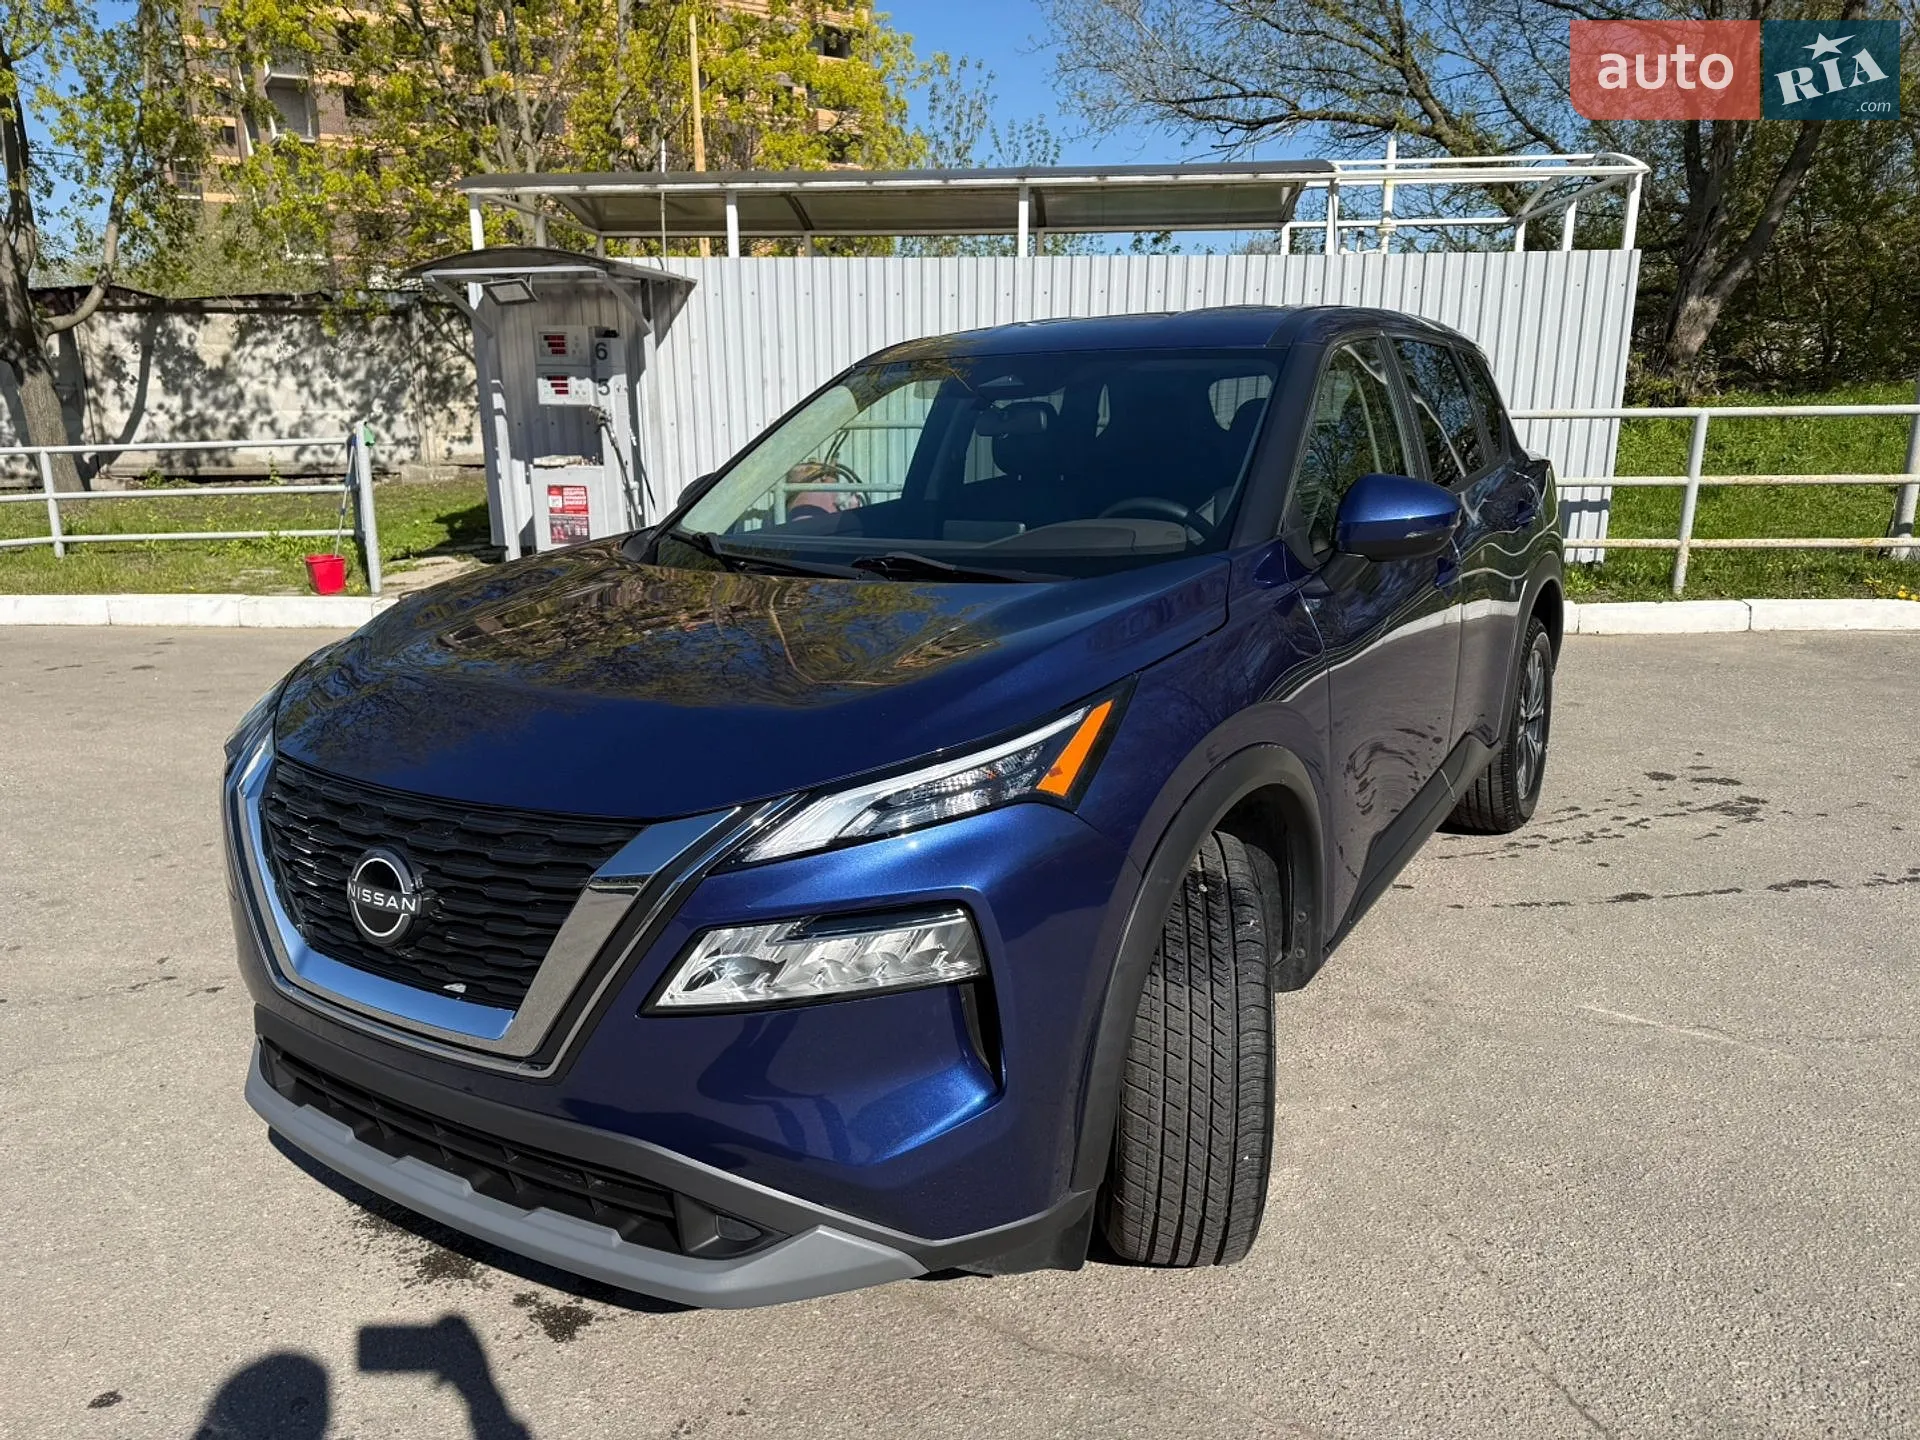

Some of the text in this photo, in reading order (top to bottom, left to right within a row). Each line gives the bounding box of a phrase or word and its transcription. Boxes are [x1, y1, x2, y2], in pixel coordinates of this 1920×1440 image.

[595, 342, 608, 360] 6
[598, 378, 610, 396] 5
[347, 881, 416, 912] NISSAN
